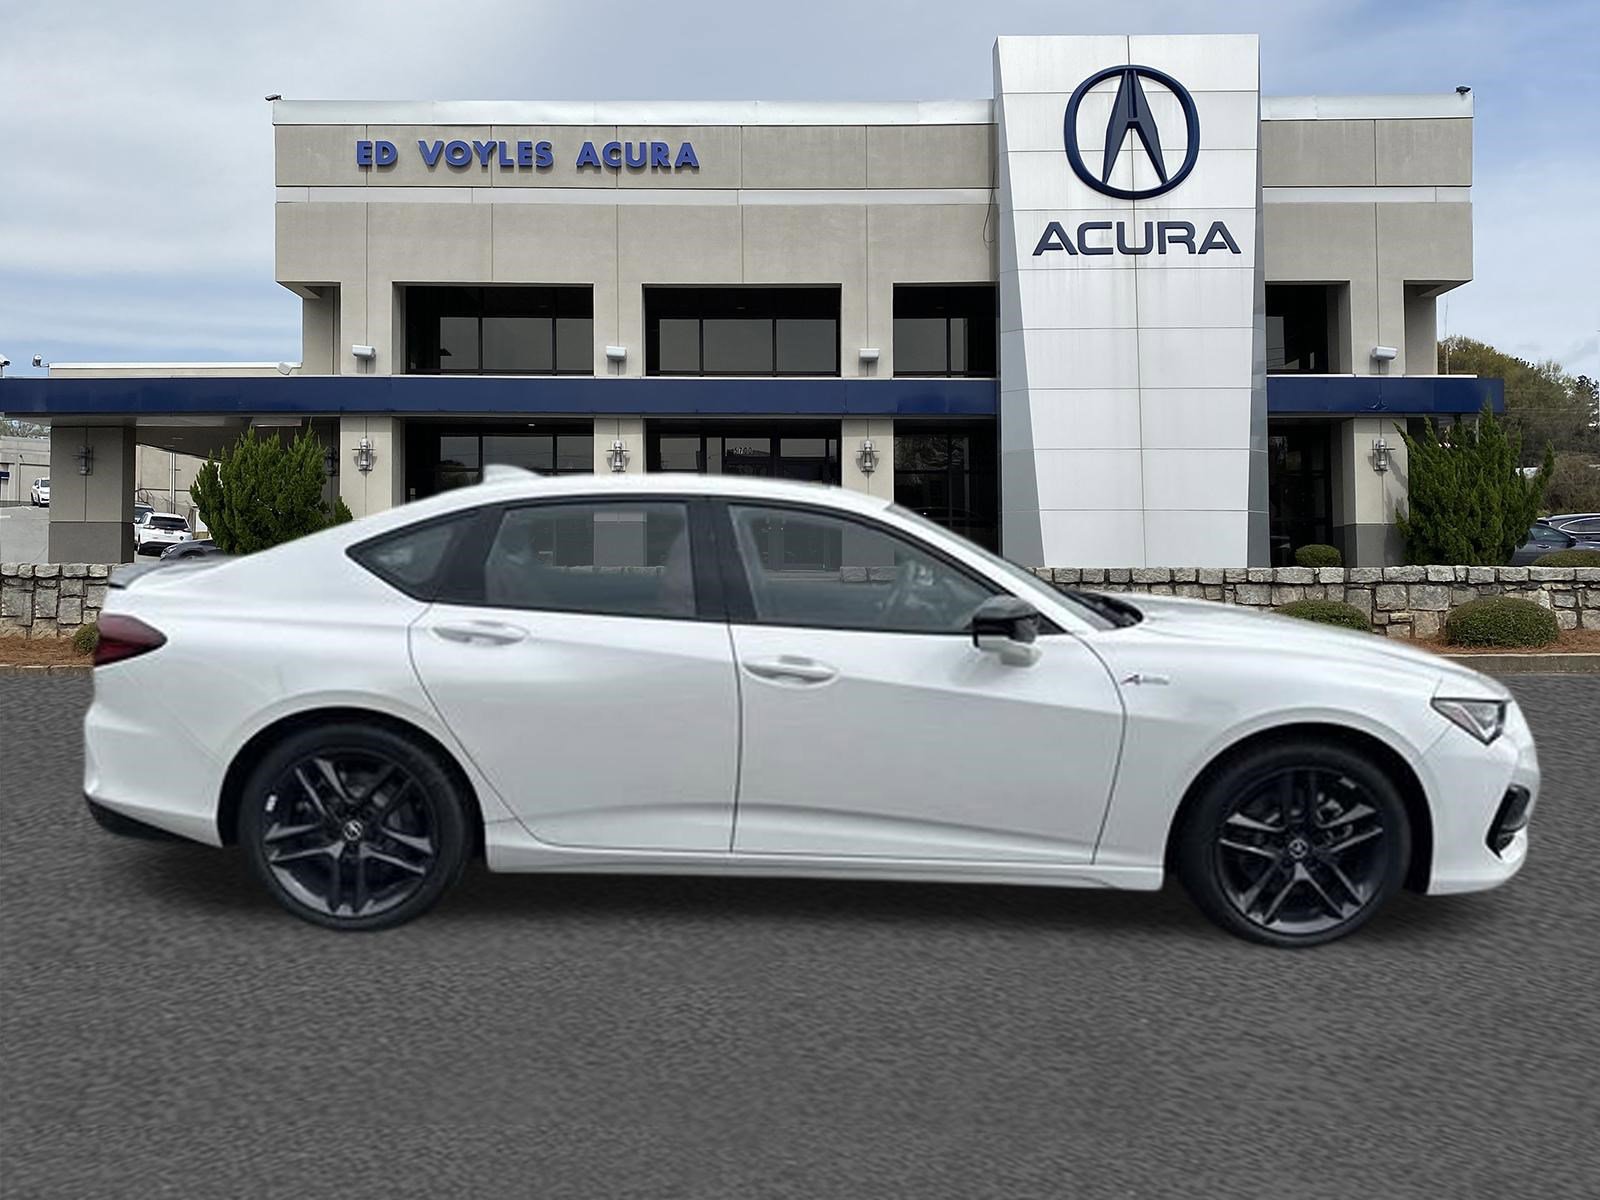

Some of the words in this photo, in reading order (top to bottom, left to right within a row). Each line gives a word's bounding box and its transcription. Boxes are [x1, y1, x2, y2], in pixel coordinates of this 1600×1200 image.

[356, 140, 398, 168] ED
[418, 140, 554, 169] VOYLES
[576, 141, 700, 170] ACURA
[1032, 221, 1242, 256] ACURA
